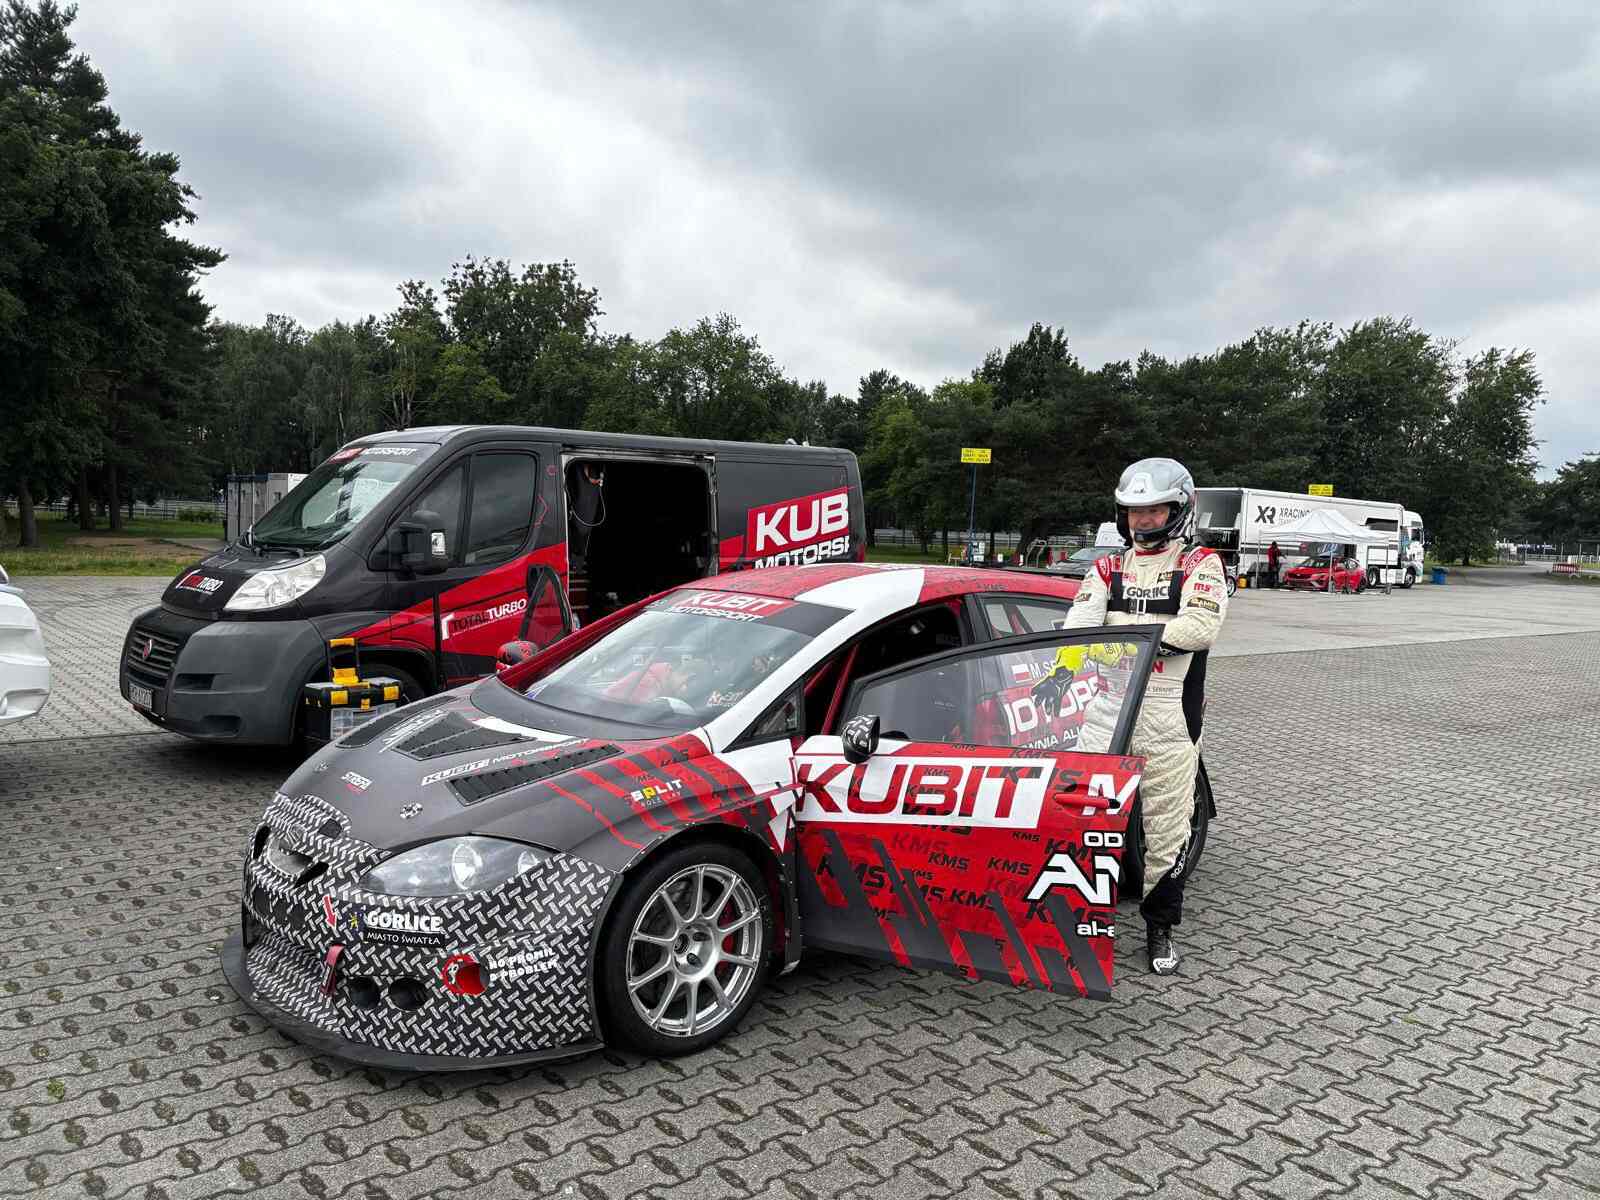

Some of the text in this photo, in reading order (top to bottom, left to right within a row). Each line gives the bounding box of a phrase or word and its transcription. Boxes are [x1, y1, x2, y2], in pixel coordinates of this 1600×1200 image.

[756, 493, 849, 551] KUB
[631, 780, 682, 801] SPLIT
[795, 763, 1045, 818] KUBIT
[928, 853, 971, 870] KMS
[987, 857, 1032, 875] KMS
[367, 911, 441, 932] GORLICE
[367, 932, 399, 942] MIASTO
